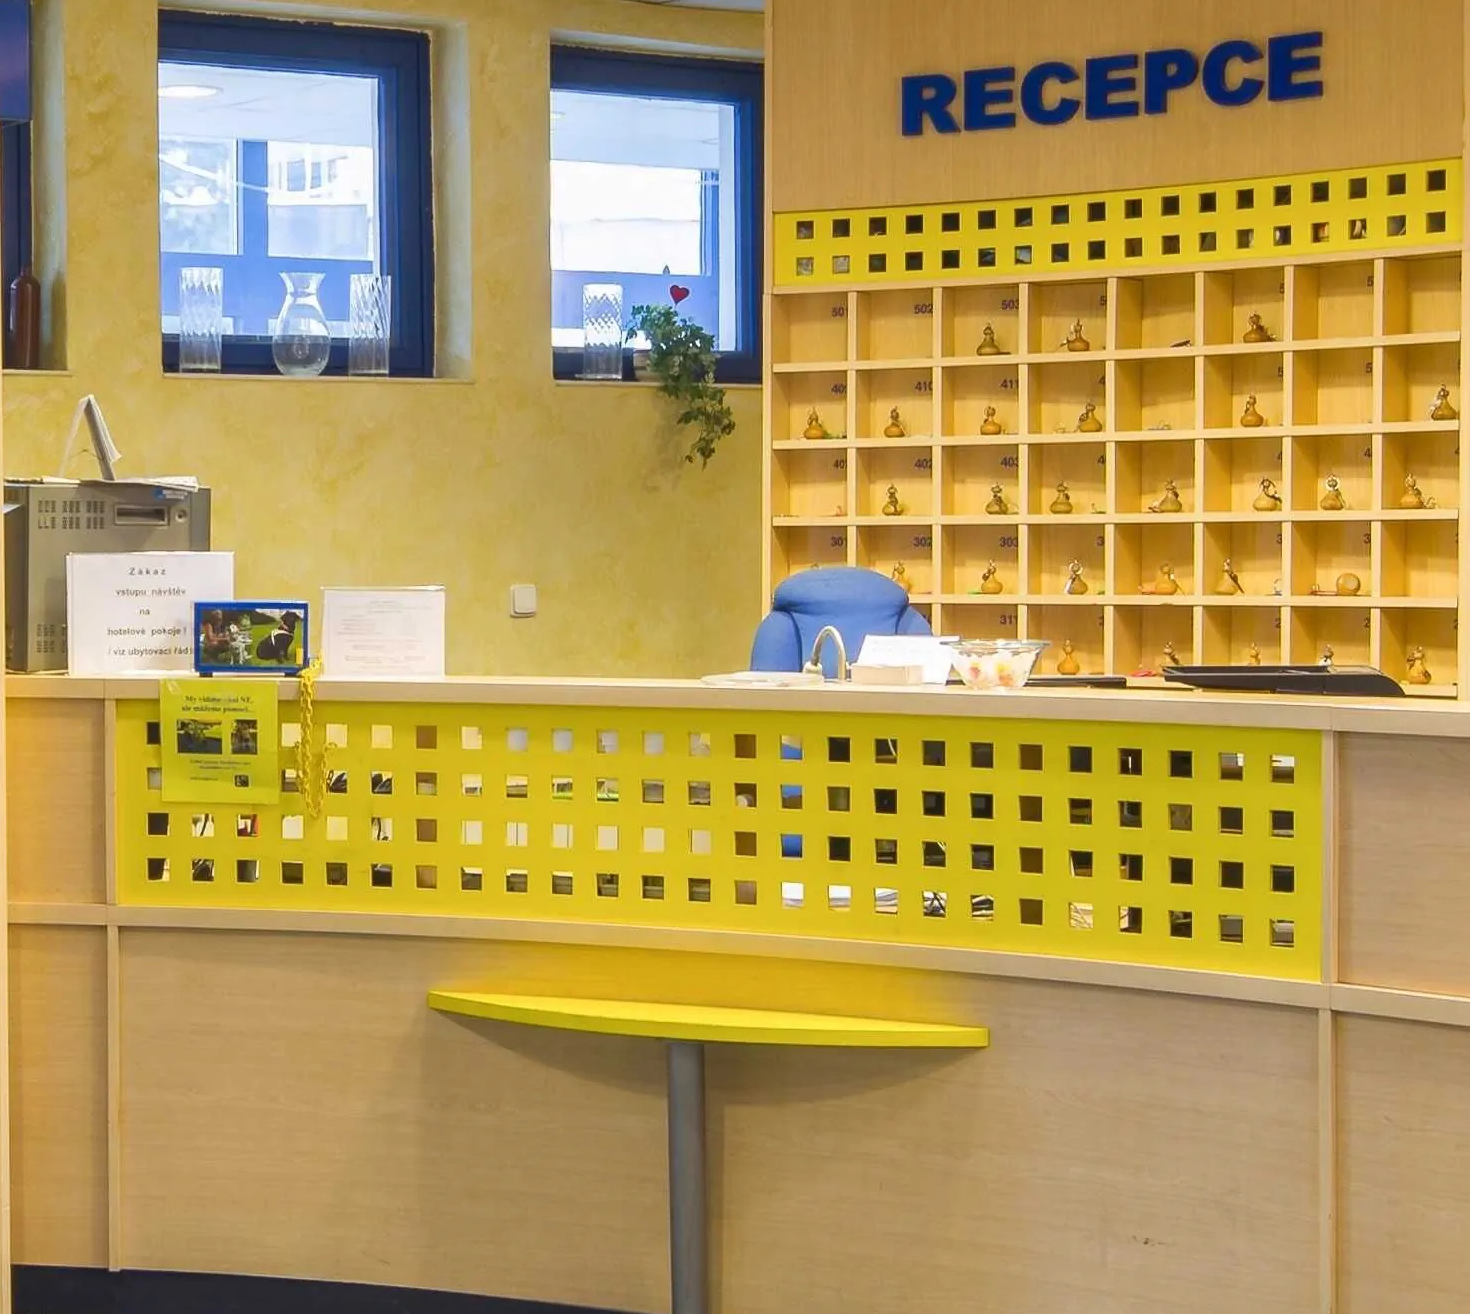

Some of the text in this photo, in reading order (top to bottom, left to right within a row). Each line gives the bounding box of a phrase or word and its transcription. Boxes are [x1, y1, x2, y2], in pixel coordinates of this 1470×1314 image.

[901, 30, 1324, 137] RECEPCE
[914, 304, 933, 315] 502
[116, 589, 147, 598] vstupu
